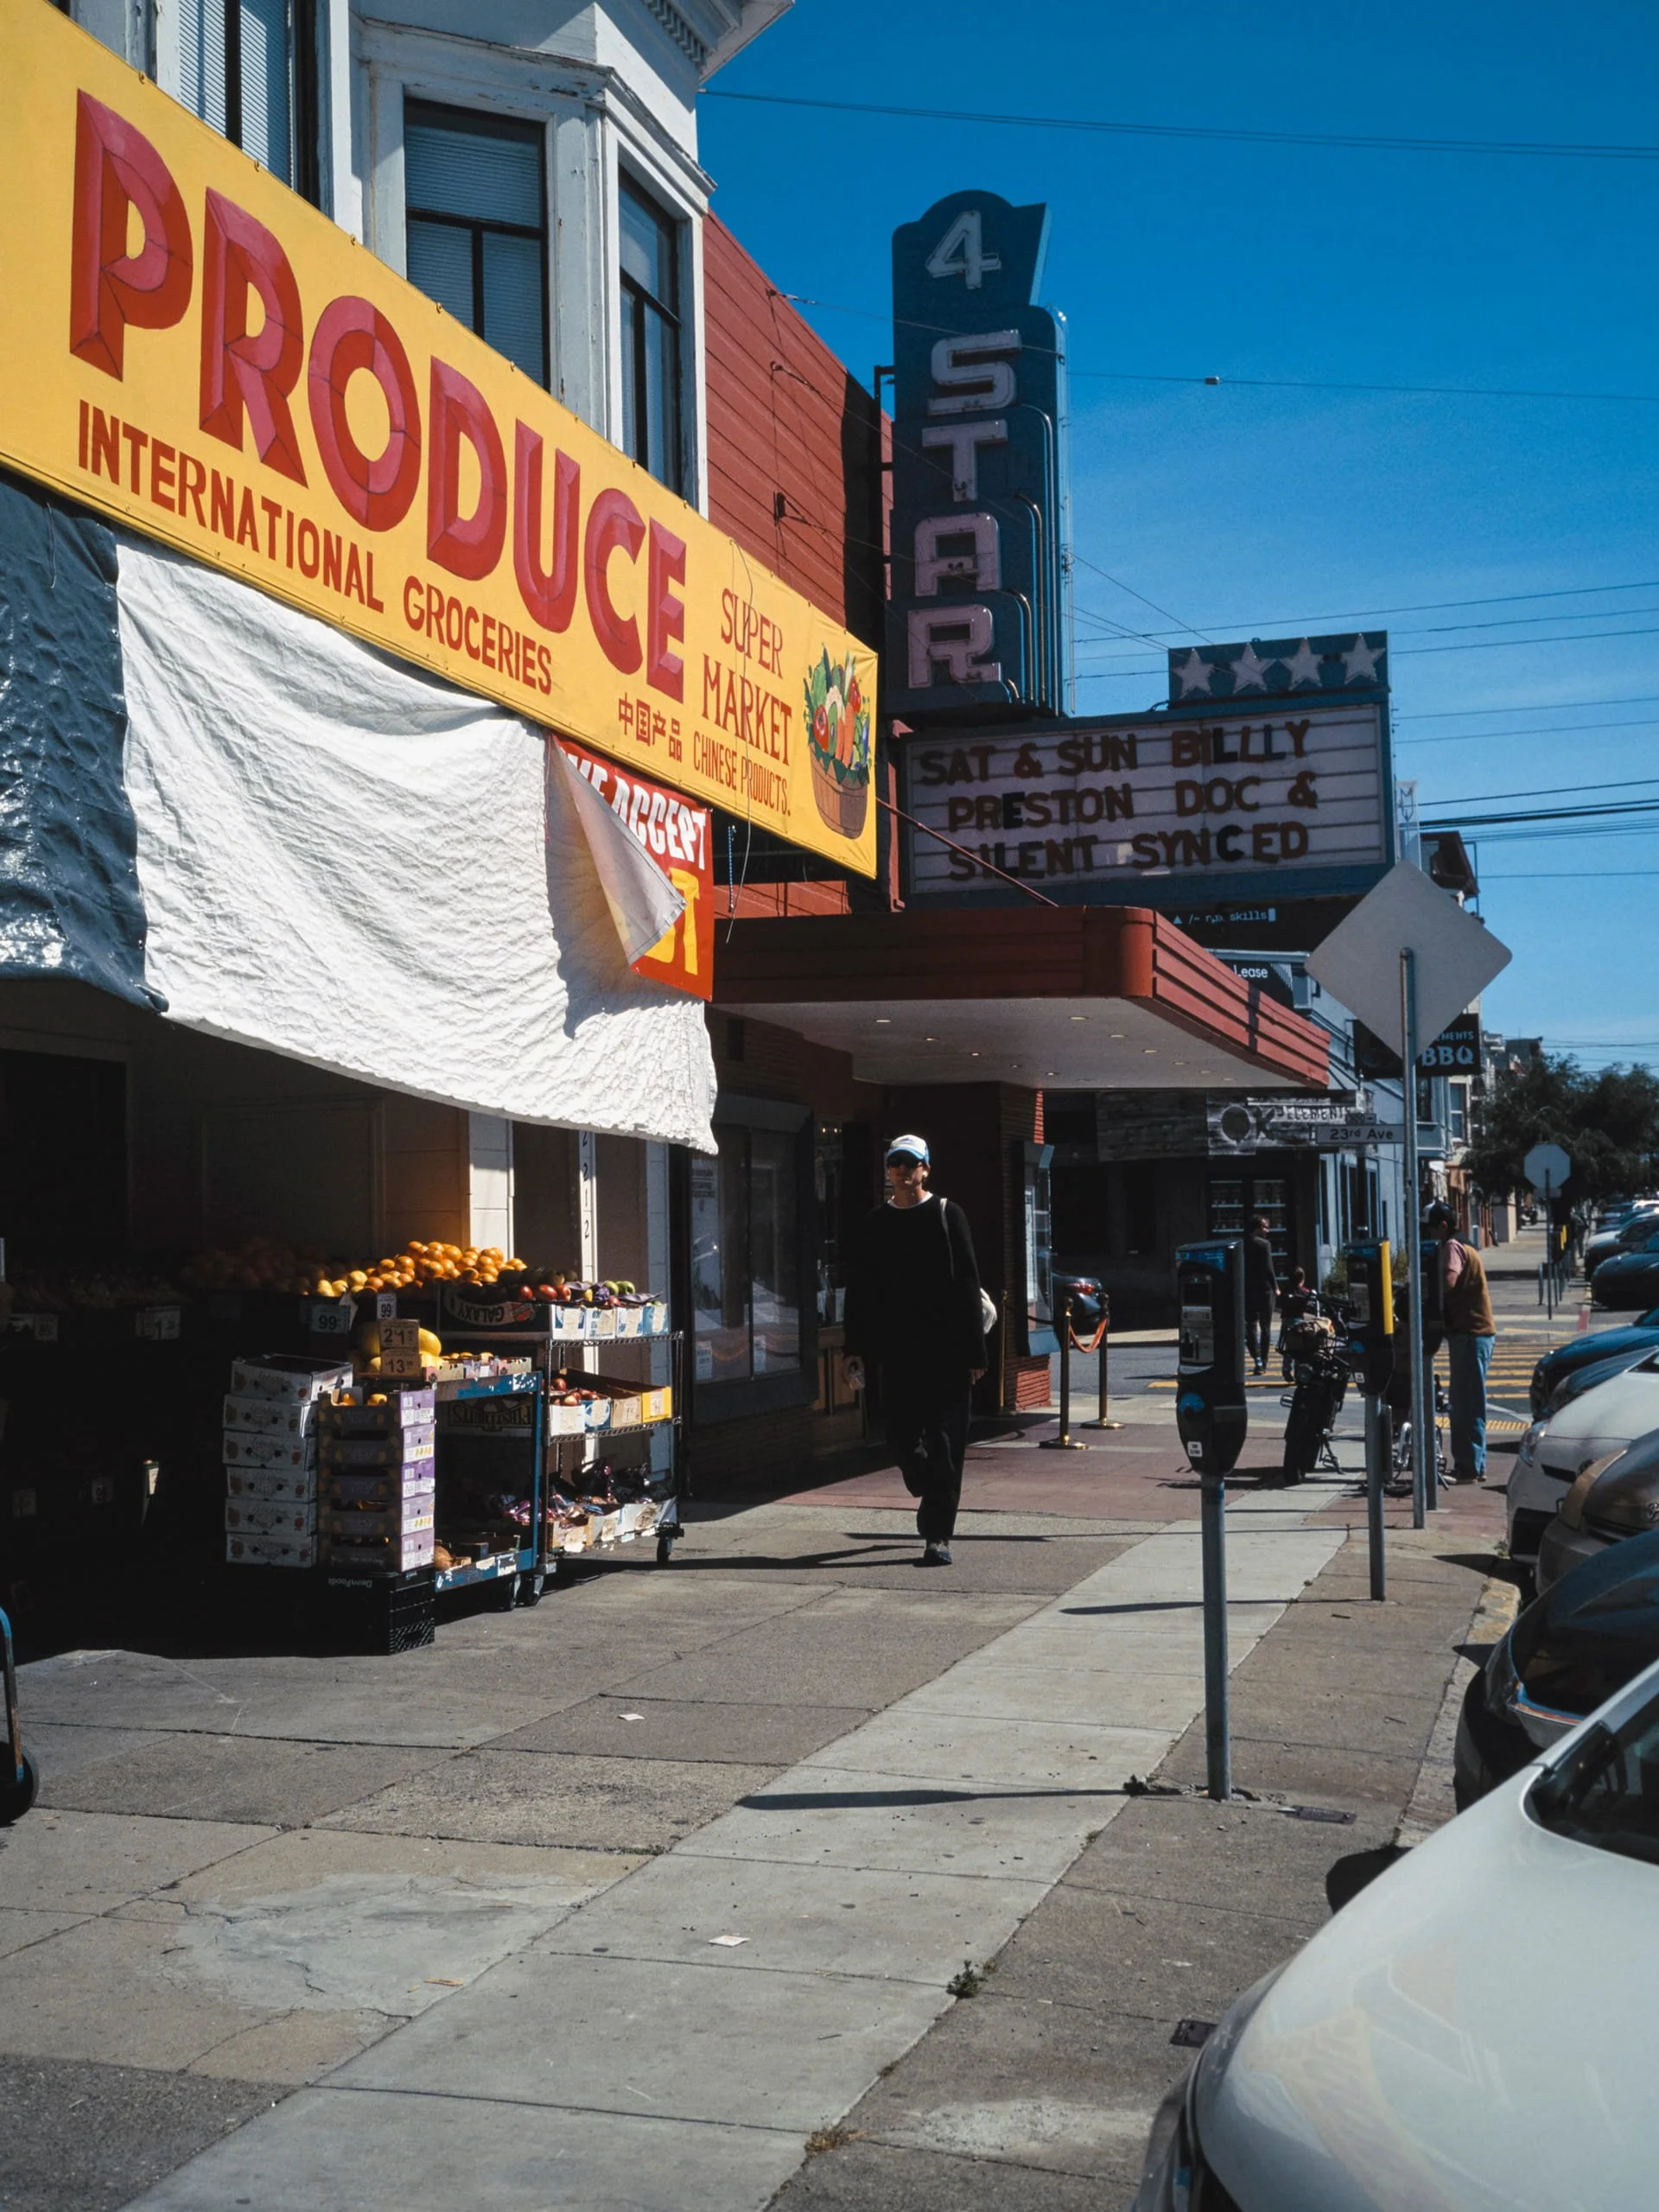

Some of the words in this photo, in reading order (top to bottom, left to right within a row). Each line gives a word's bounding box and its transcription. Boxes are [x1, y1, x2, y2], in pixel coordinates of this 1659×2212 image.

[925, 210, 1001, 289] 4
[71, 89, 685, 703] PRODUCE
[907, 329, 1022, 689] STAR
[79, 400, 384, 613] INTERNATIONAL
[404, 576, 552, 696] GROCERIES
[721, 588, 783, 680] SUPER
[618, 692, 683, 763] 中国产品
[702, 653, 792, 766] MARKET
[693, 730, 737, 791] CHINESE
[741, 756, 791, 817] PRODUCTS.
[920, 746, 995, 785] SAT
[1014, 743, 1044, 778] &
[1057, 734, 1138, 776] SUN
[611, 775, 706, 871] ACCEPT
[949, 783, 1135, 832] PRESTON
[1175, 776, 1261, 817] DOC
[1287, 771, 1319, 810] &
[948, 835, 1099, 881] SILENT
[1132, 822, 1309, 870] SYNCED
[1230, 911, 1267, 922] skills
[1233, 964, 1268, 978] Lease
[1421, 1044, 1475, 1067] BBQ
[1330, 1128, 1361, 1140] 23rd
[1367, 1128, 1394, 1140] Ave
[318, 1314, 338, 1331] 99
[381, 1303, 391, 1318] 99
[458, 1302, 505, 1323] GALAXY
